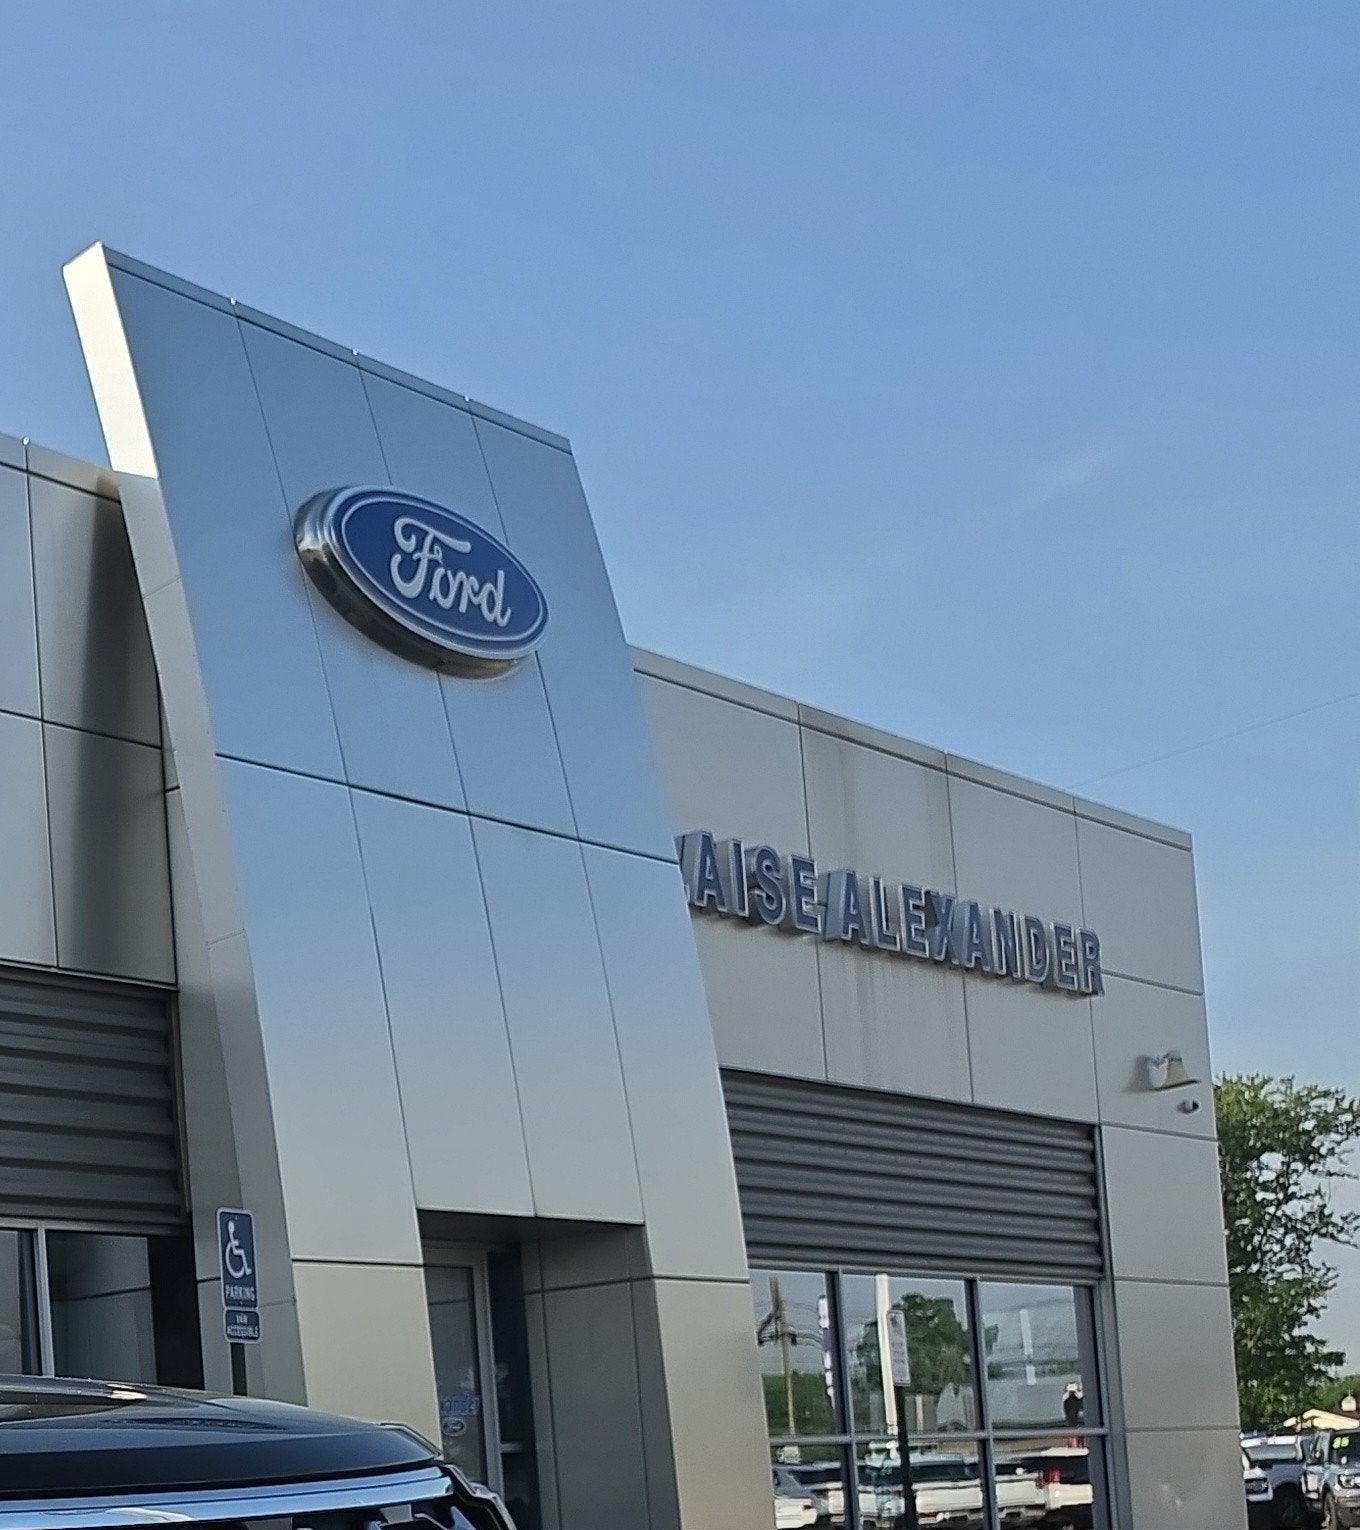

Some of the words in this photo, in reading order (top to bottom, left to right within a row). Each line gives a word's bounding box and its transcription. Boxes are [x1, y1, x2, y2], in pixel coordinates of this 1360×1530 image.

[389, 516, 511, 627] Ford
[674, 828, 821, 934] AISE
[824, 868, 1105, 998] ALEXANDER
[225, 1284, 255, 1301] PARKING
